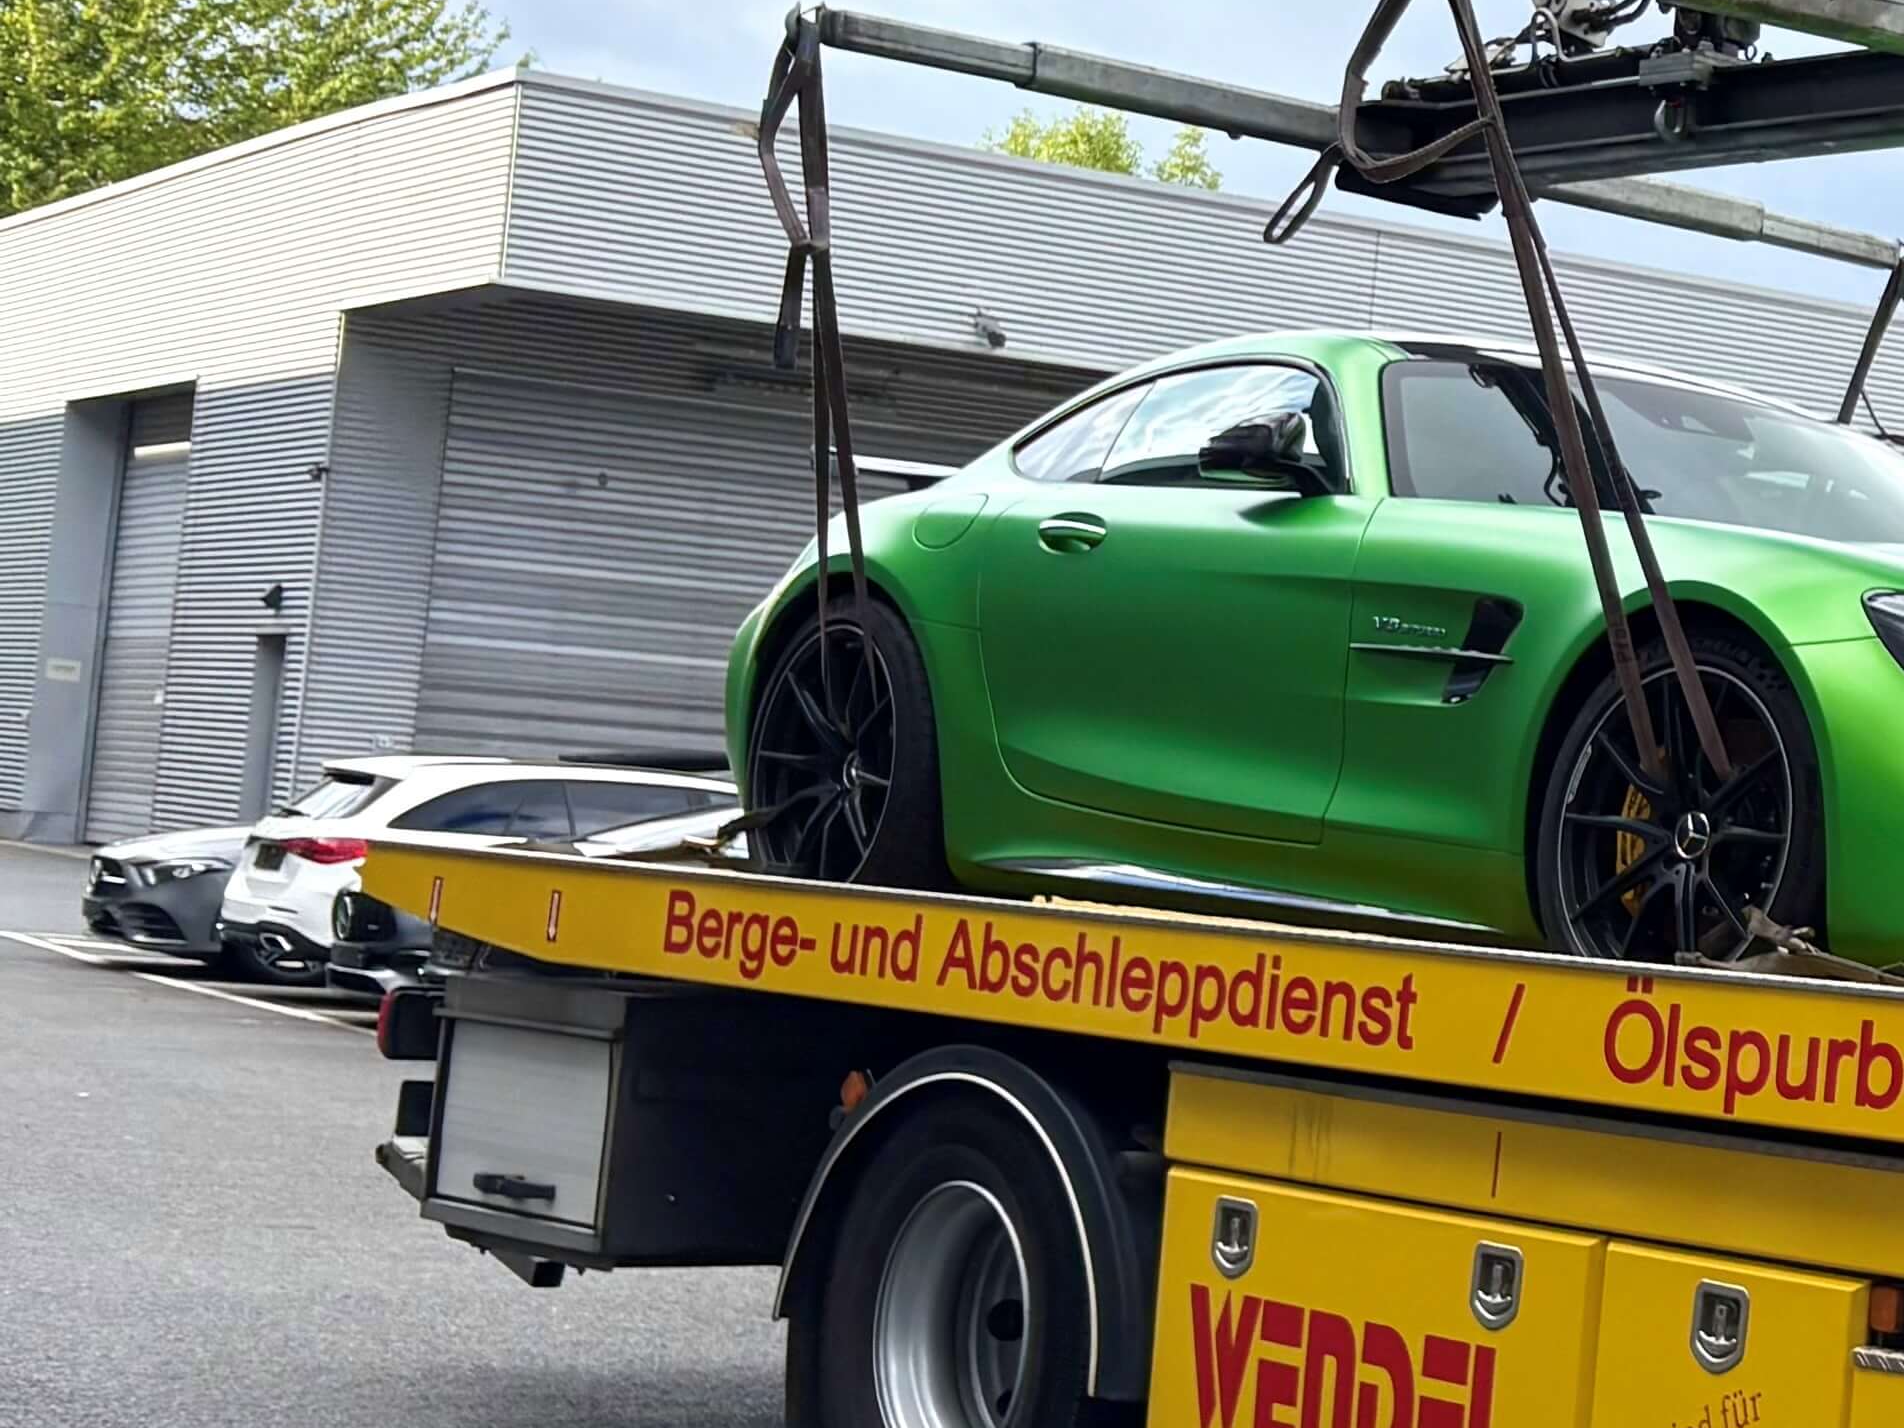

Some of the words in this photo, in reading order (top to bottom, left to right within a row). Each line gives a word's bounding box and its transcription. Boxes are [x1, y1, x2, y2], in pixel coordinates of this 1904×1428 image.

[663, 888, 817, 981] Berge-
[829, 913, 924, 983] und
[936, 917, 1419, 1052] Abschleppdienst
